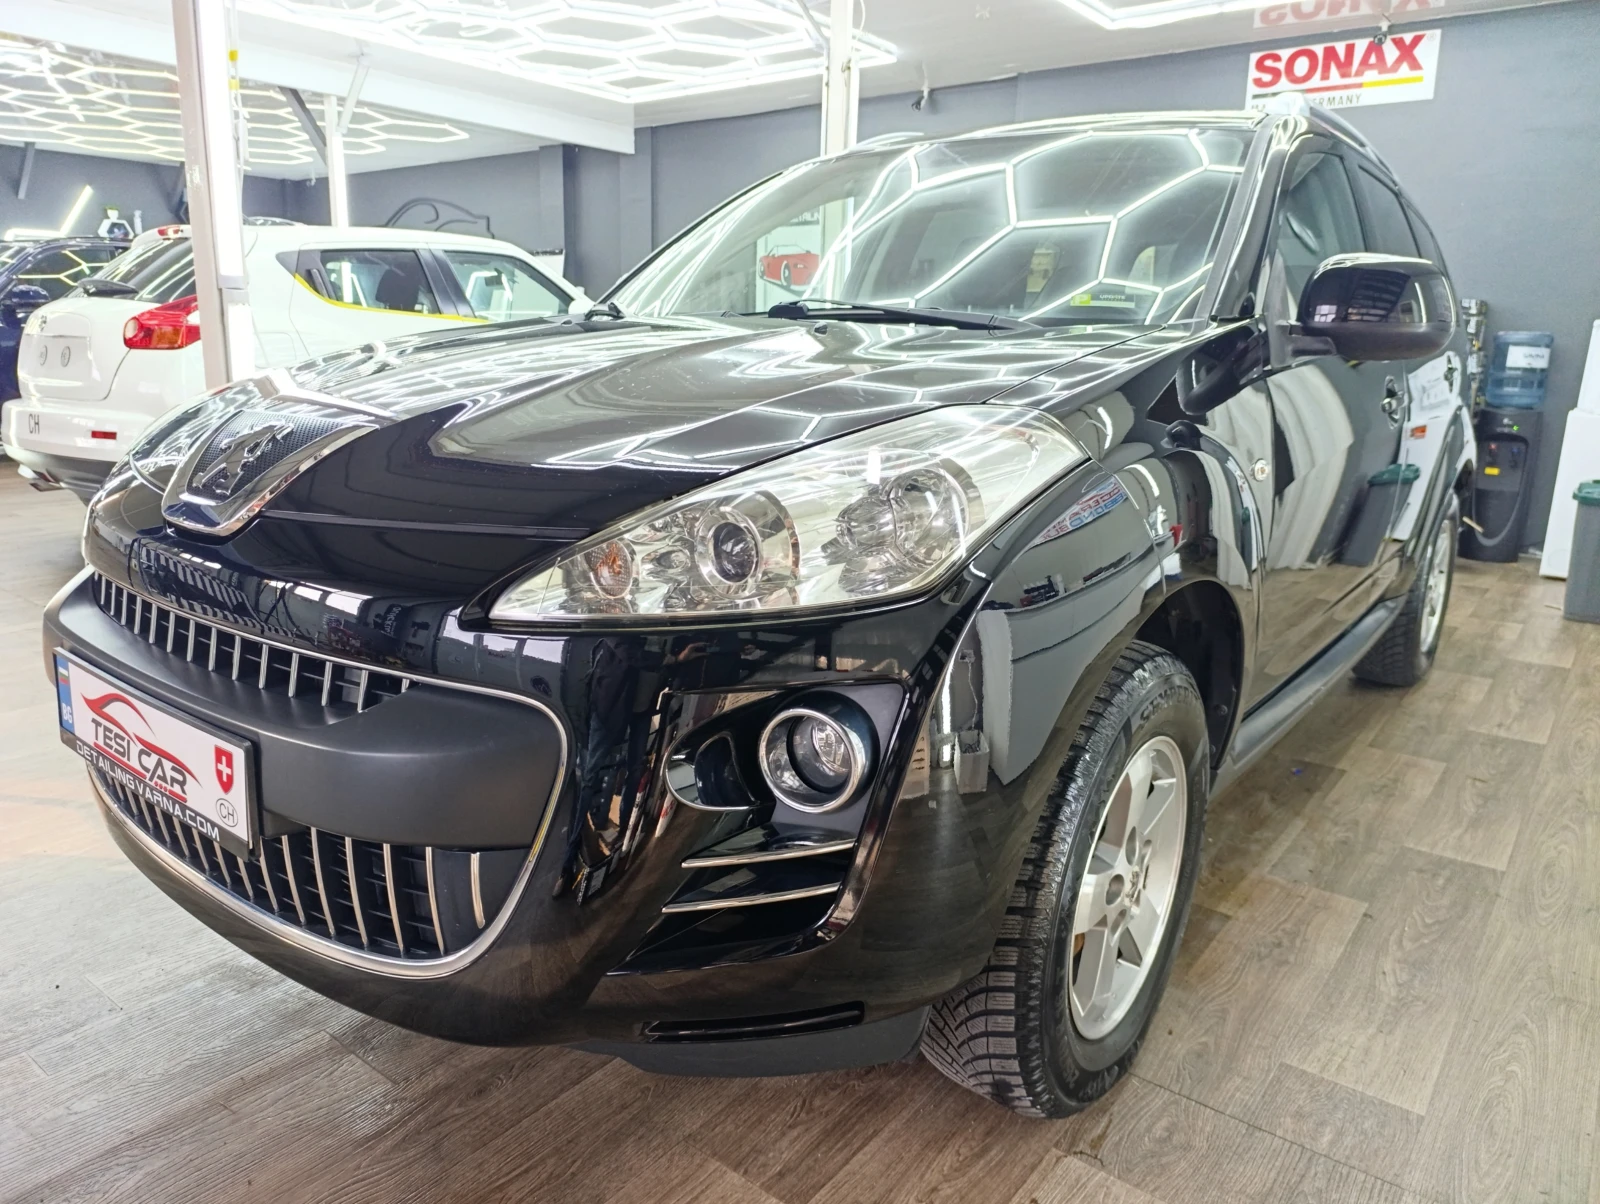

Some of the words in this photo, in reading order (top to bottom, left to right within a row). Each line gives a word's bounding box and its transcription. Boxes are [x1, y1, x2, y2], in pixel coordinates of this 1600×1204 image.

[1252, 34, 1427, 89] SONAX
[28, 413, 40, 435] CH
[62, 703, 73, 724] BG
[91, 718, 131, 763] TESI
[138, 749, 188, 796] CAR
[219, 803, 236, 823] CH
